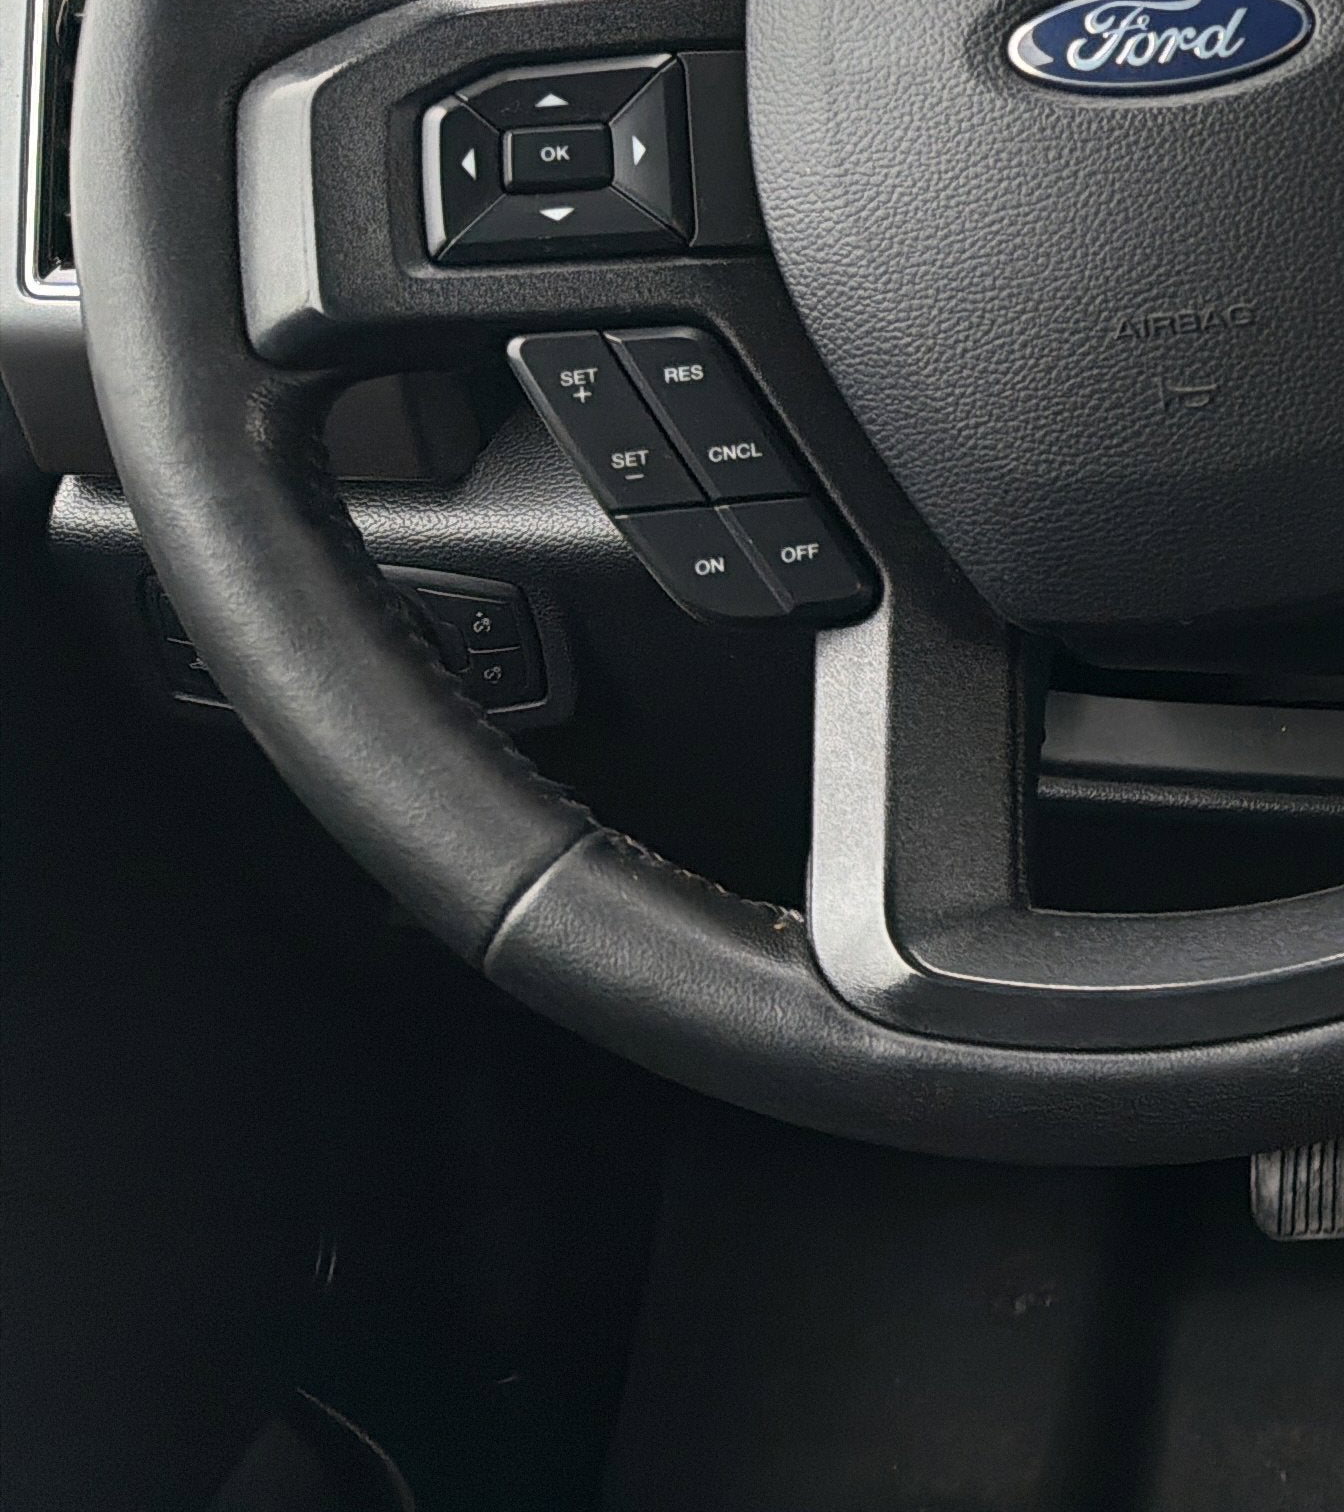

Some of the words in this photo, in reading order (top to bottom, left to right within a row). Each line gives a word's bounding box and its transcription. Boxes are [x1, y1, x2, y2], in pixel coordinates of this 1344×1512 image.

[539, 145, 571, 163] OK
[1114, 302, 1258, 340] AIRBAG
[559, 367, 598, 388] SET
[663, 365, 704, 384] RES
[610, 449, 650, 469] SET
[707, 443, 763, 464] CNCL
[780, 542, 820, 564] OFF
[694, 556, 726, 577] ON
